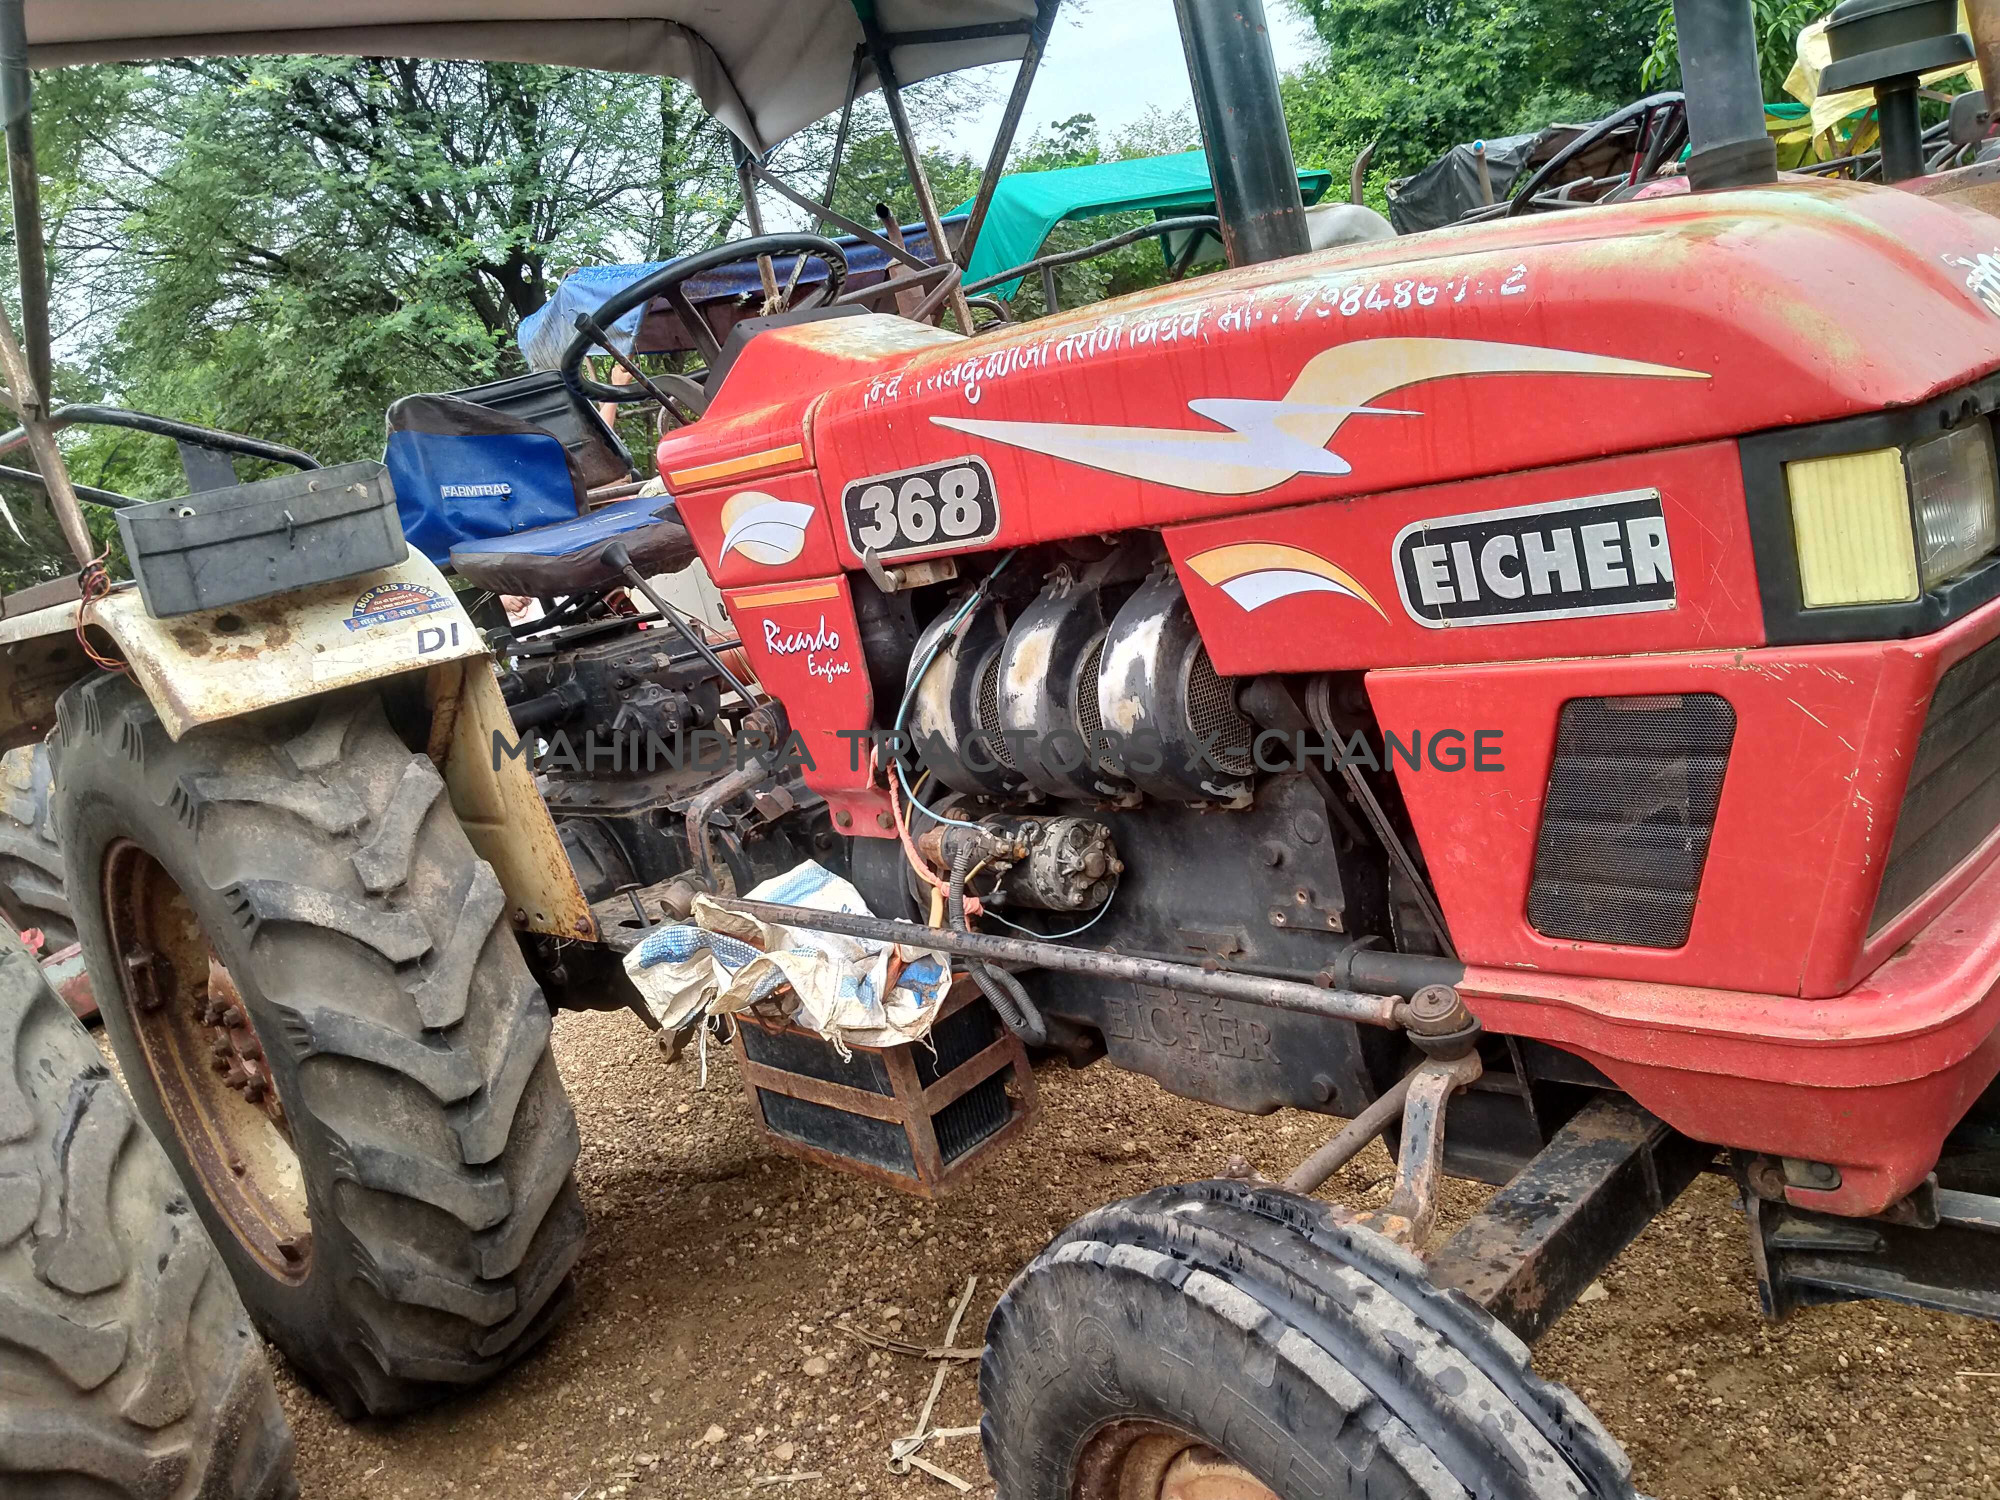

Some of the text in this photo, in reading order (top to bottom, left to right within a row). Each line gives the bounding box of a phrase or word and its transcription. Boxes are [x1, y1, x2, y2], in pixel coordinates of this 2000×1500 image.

[859, 467, 982, 549] 368
[1412, 516, 1674, 606] EICHER
[354, 583, 435, 614] 1800 425 9798
[417, 622, 459, 655] DI
[763, 614, 840, 655] Ricardo
[808, 653, 851, 683] Engine
[1104, 996, 1283, 1065] EICHER
